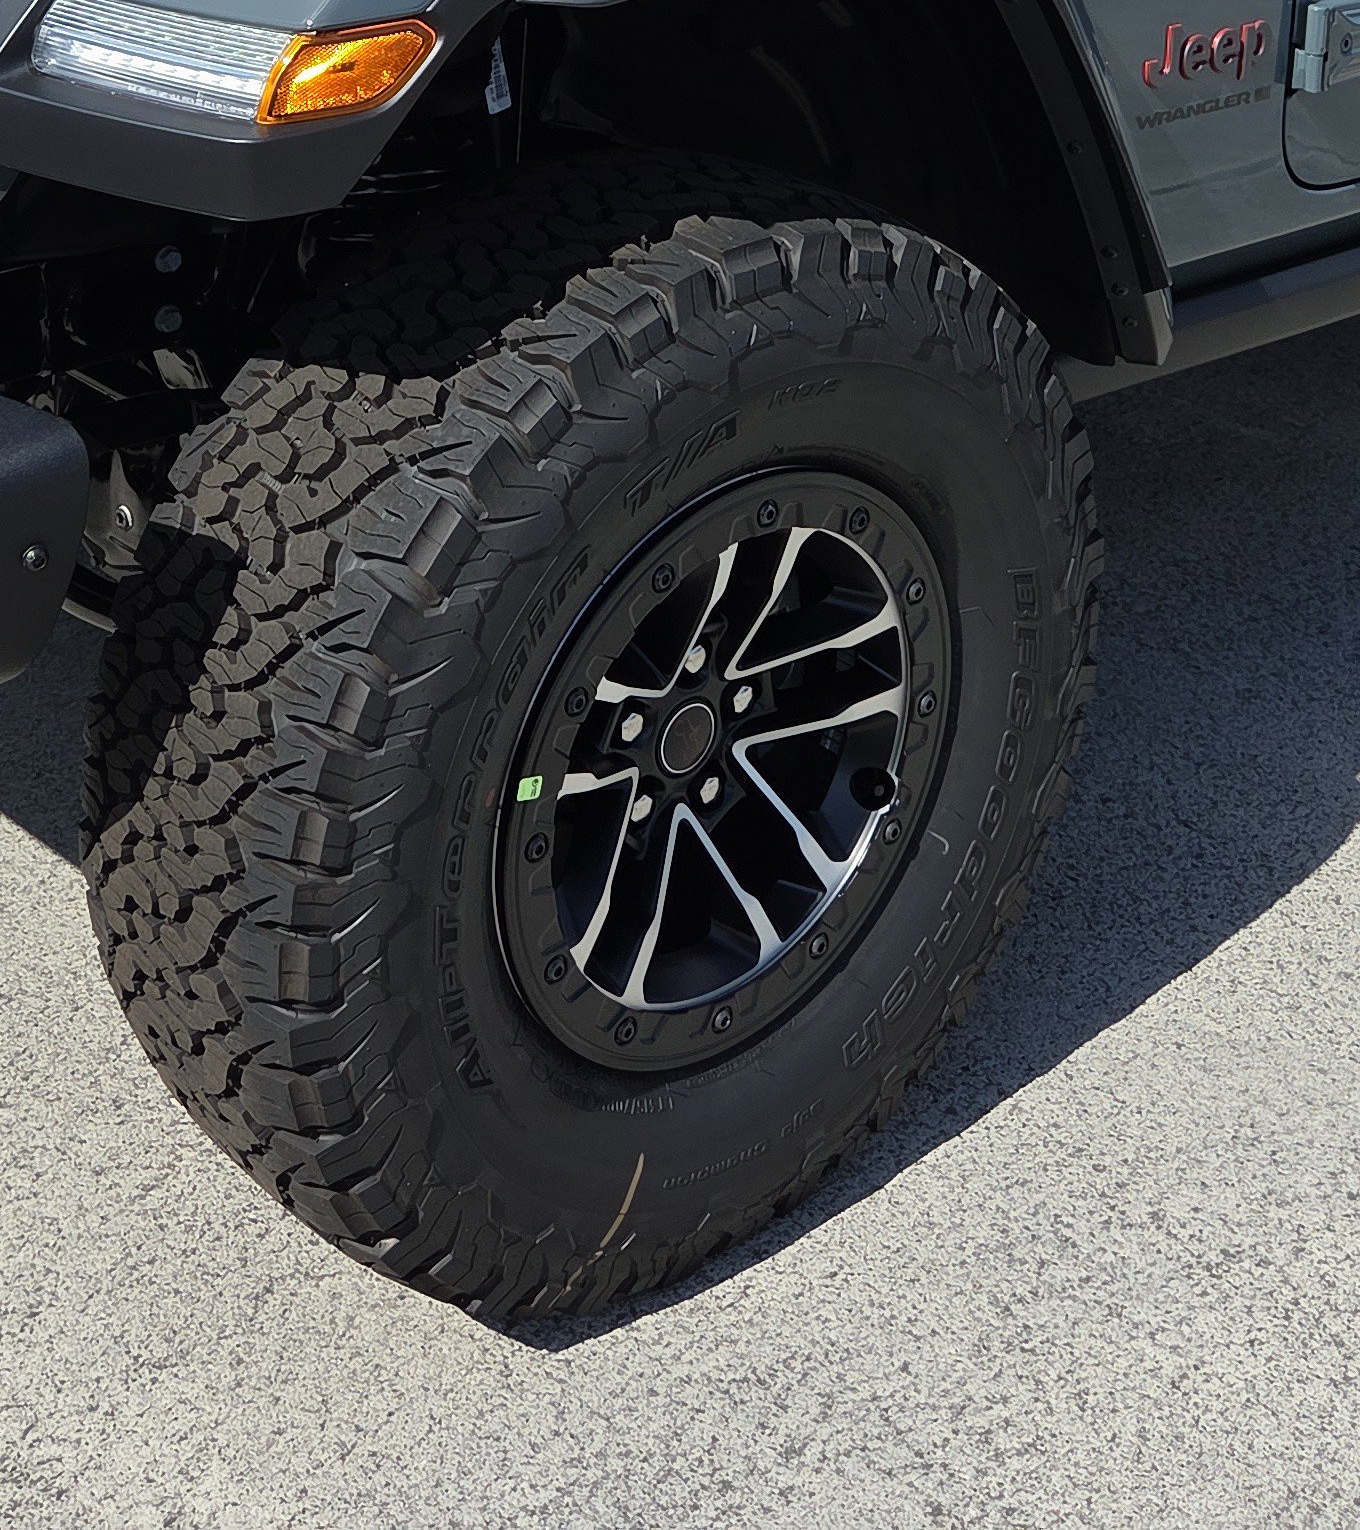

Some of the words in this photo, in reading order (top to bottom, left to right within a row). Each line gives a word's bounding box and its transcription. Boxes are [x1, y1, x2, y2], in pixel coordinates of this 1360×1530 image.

[1142, 19, 1273, 90] Jeep
[1136, 92, 1251, 131] WRANGLER
[842, 567, 1041, 1068] BFGoodrich
